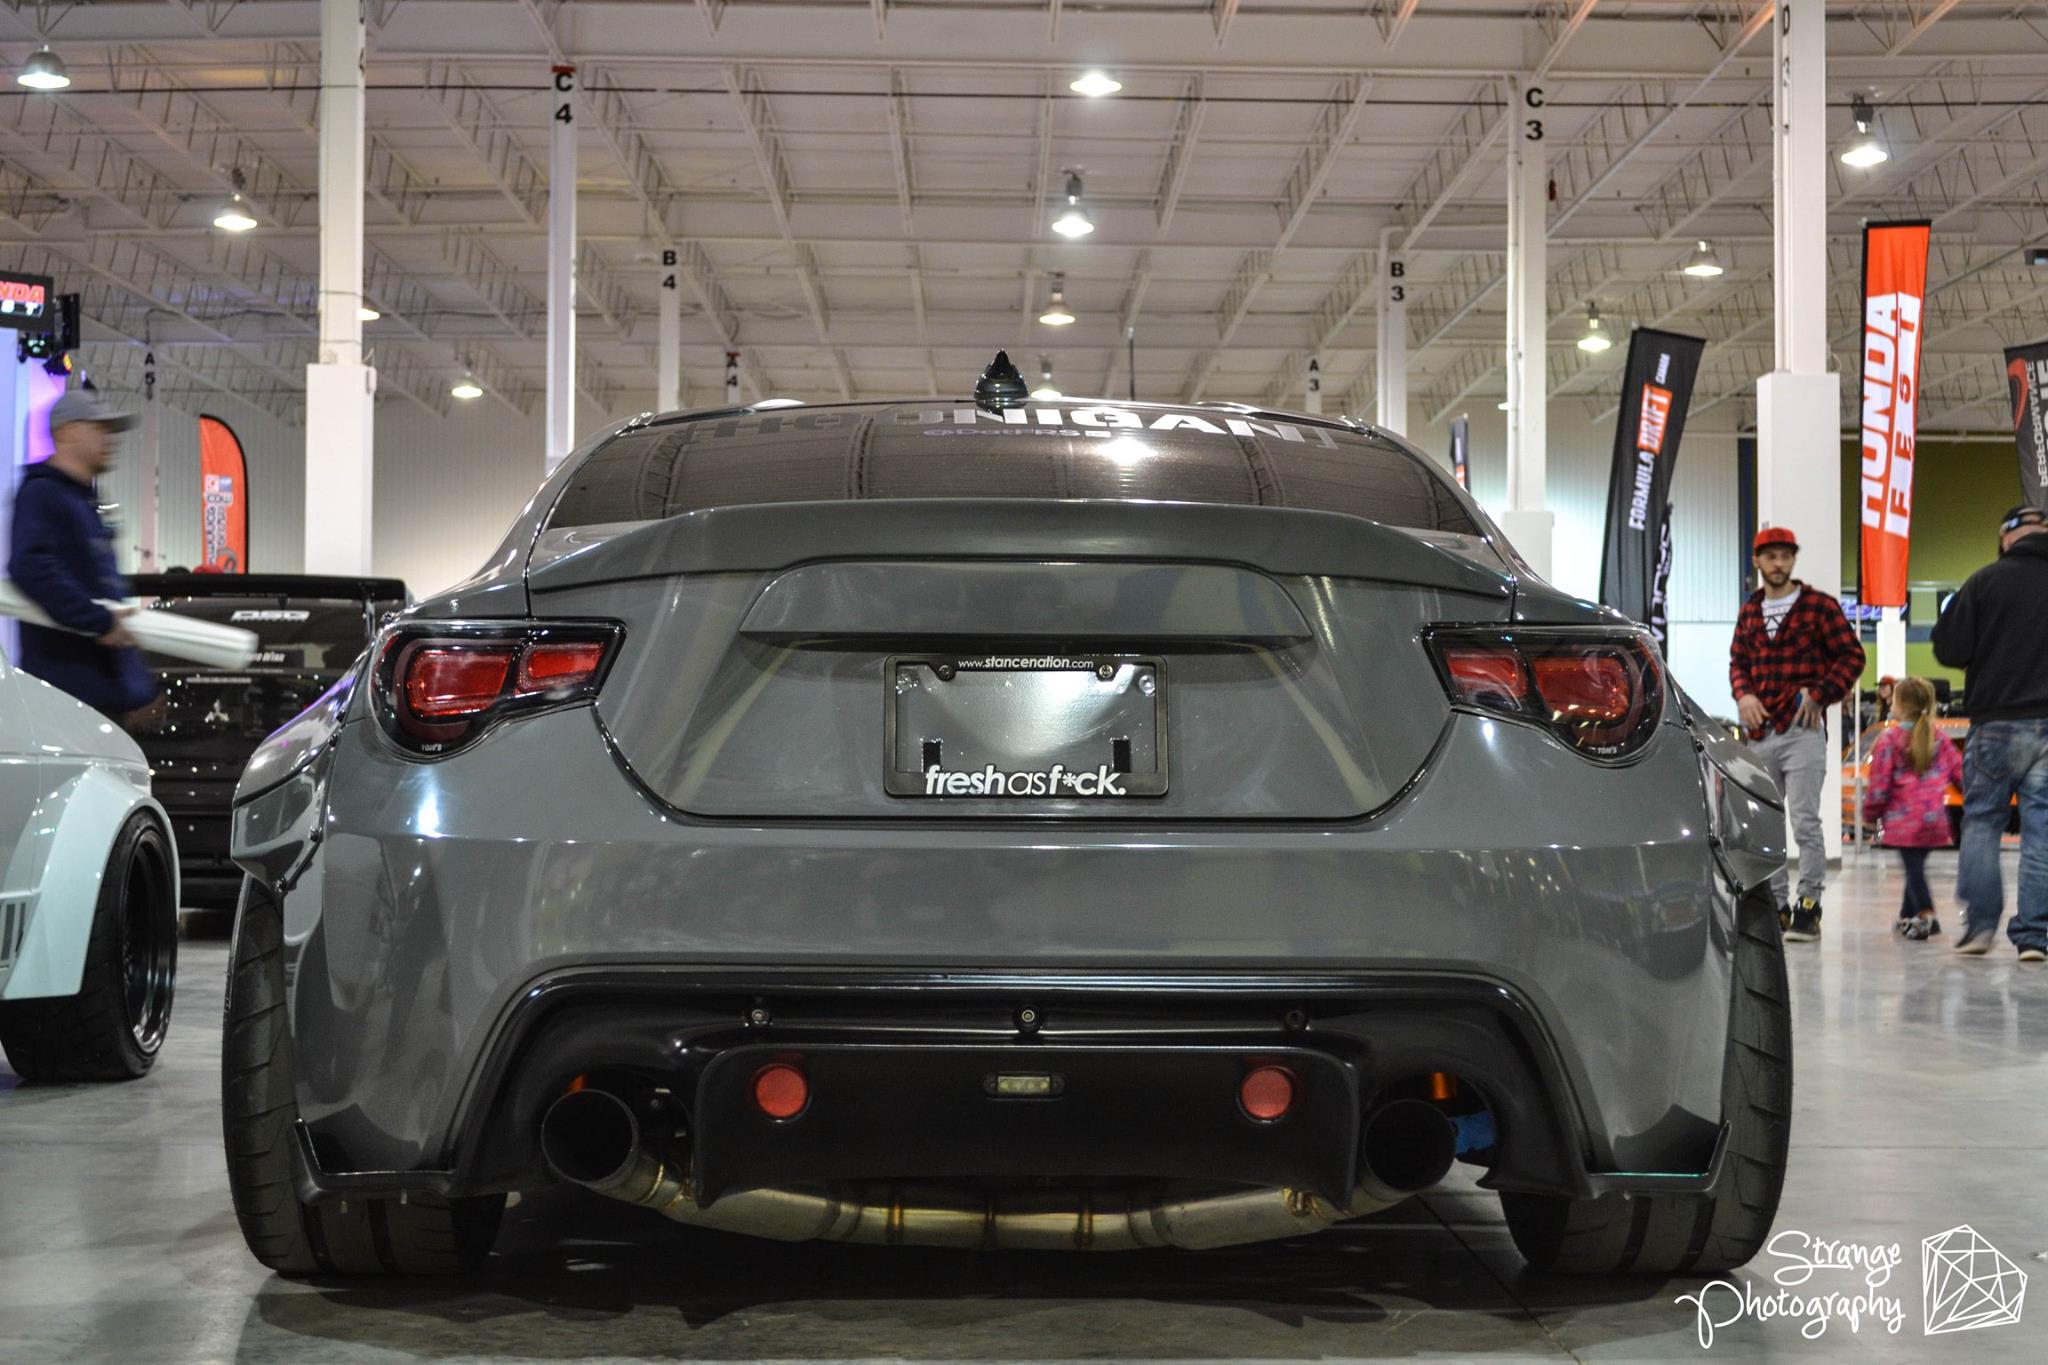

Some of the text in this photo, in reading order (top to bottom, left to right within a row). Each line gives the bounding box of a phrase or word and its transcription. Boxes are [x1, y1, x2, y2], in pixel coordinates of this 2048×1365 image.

[555, 73, 573, 123] C 4
[1526, 87, 1544, 140] C 3
[662, 249, 677, 289] B 4
[1390, 261, 1405, 302] B 3
[144, 352, 156, 366] A
[1309, 359, 1320, 392] A 3
[1639, 384, 1670, 451] DRIFT
[1861, 292, 1898, 530] HONDA
[1889, 306, 1917, 519] FEST
[1628, 450, 1655, 532] FORMULA
[958, 656, 1094, 669] www.stancenation.com
